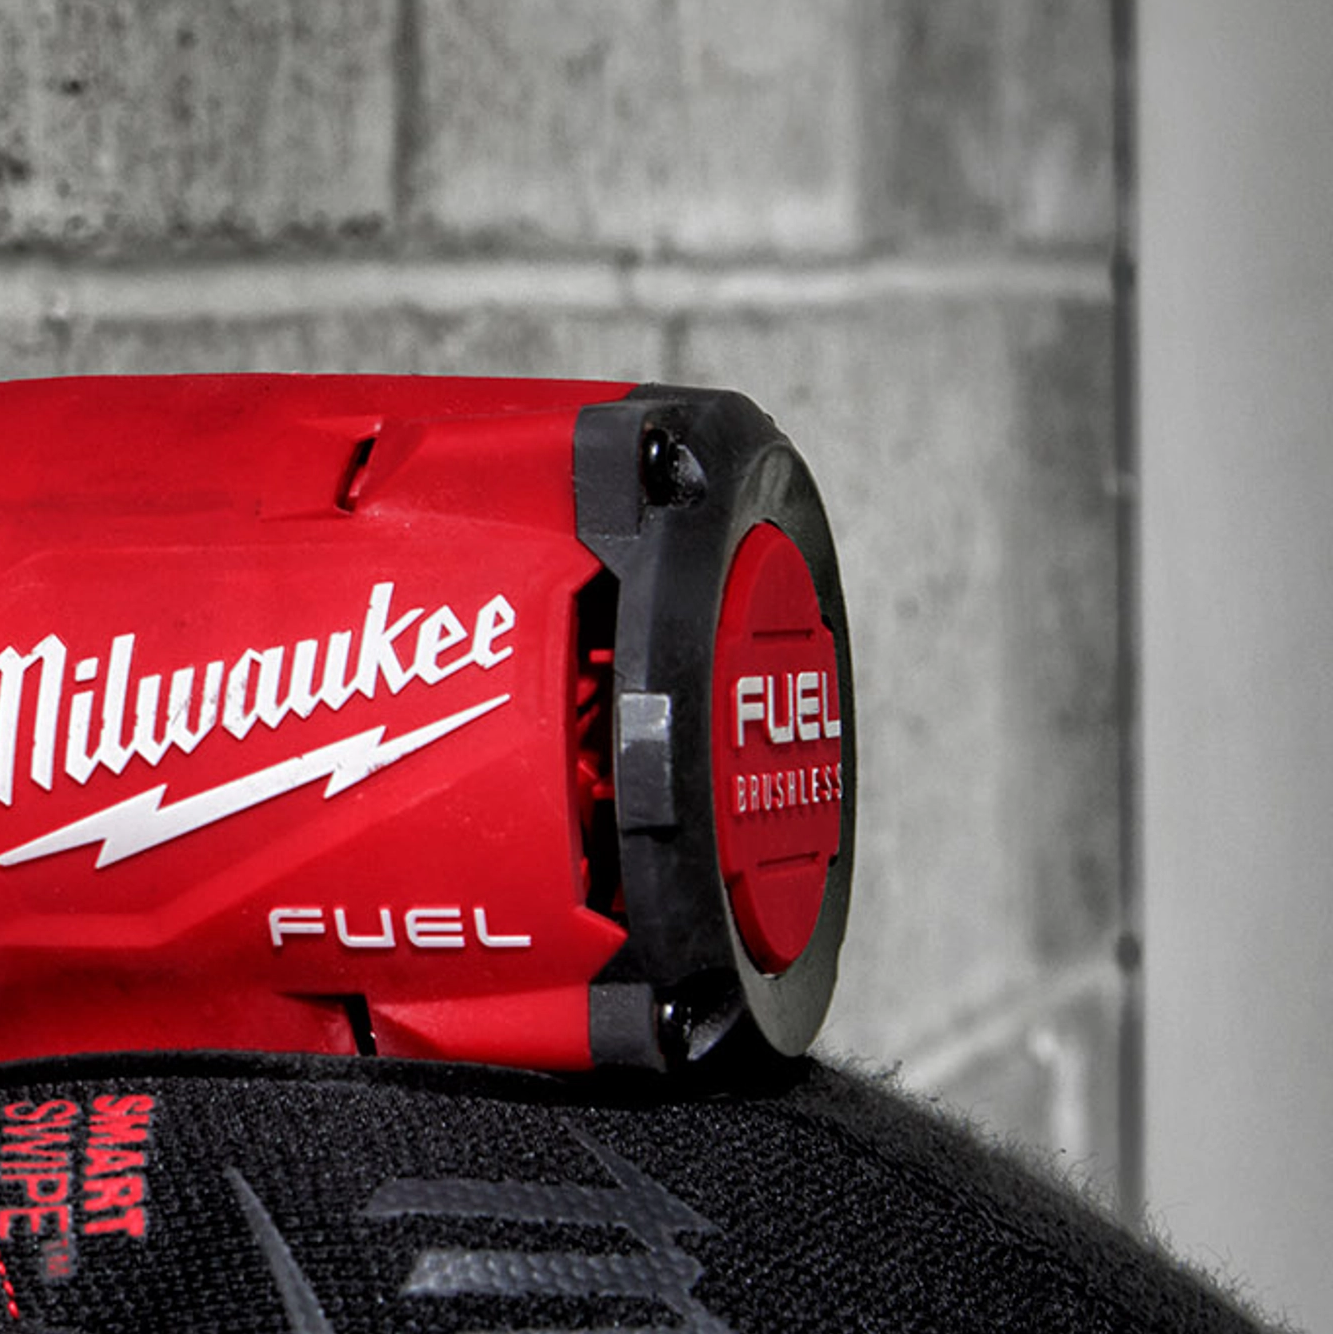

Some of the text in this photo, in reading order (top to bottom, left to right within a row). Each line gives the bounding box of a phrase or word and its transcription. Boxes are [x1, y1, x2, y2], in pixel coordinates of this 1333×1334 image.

[736, 670, 842, 747] FUEL
[736, 763, 843, 813] BRUSHLESS
[267, 907, 532, 948] FUEL
[83, 1094, 155, 1238] SMART
